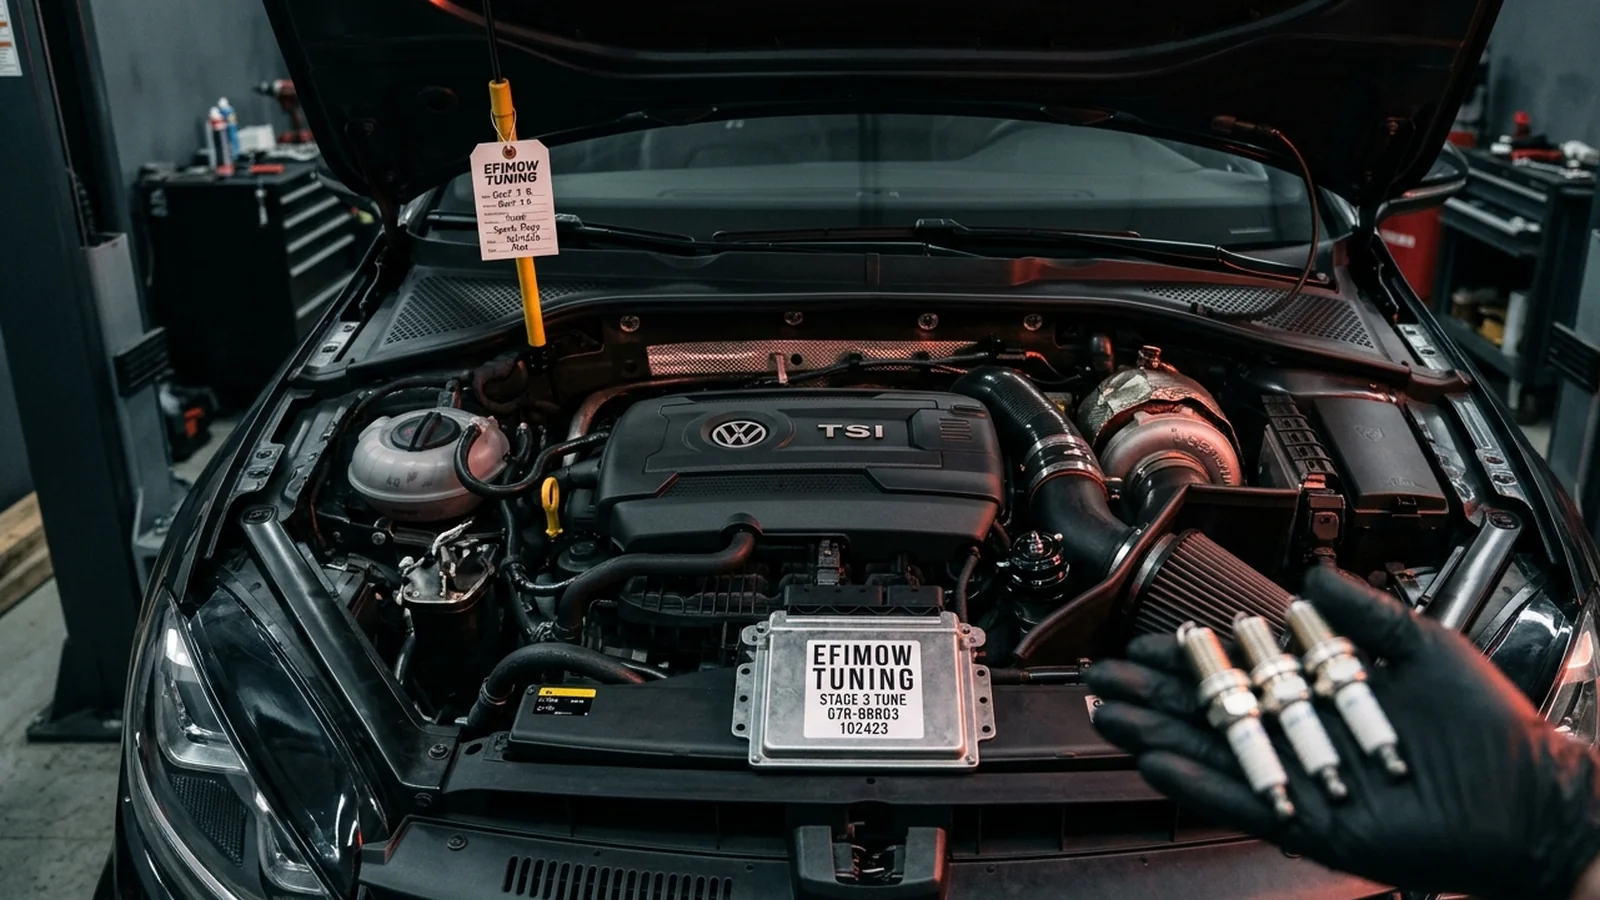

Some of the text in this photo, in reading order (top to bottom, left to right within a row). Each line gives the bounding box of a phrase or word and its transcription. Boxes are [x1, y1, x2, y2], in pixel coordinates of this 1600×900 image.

[484, 160, 539, 174] EFIMOW
[485, 172, 538, 185] TUNING
[818, 424, 884, 440] TSI
[813, 644, 912, 666] EFIMOW
[812, 667, 914, 690] TUNING
[820, 693, 907, 706] STAGE 3 TUNE
[840, 722, 888, 735] 102423
